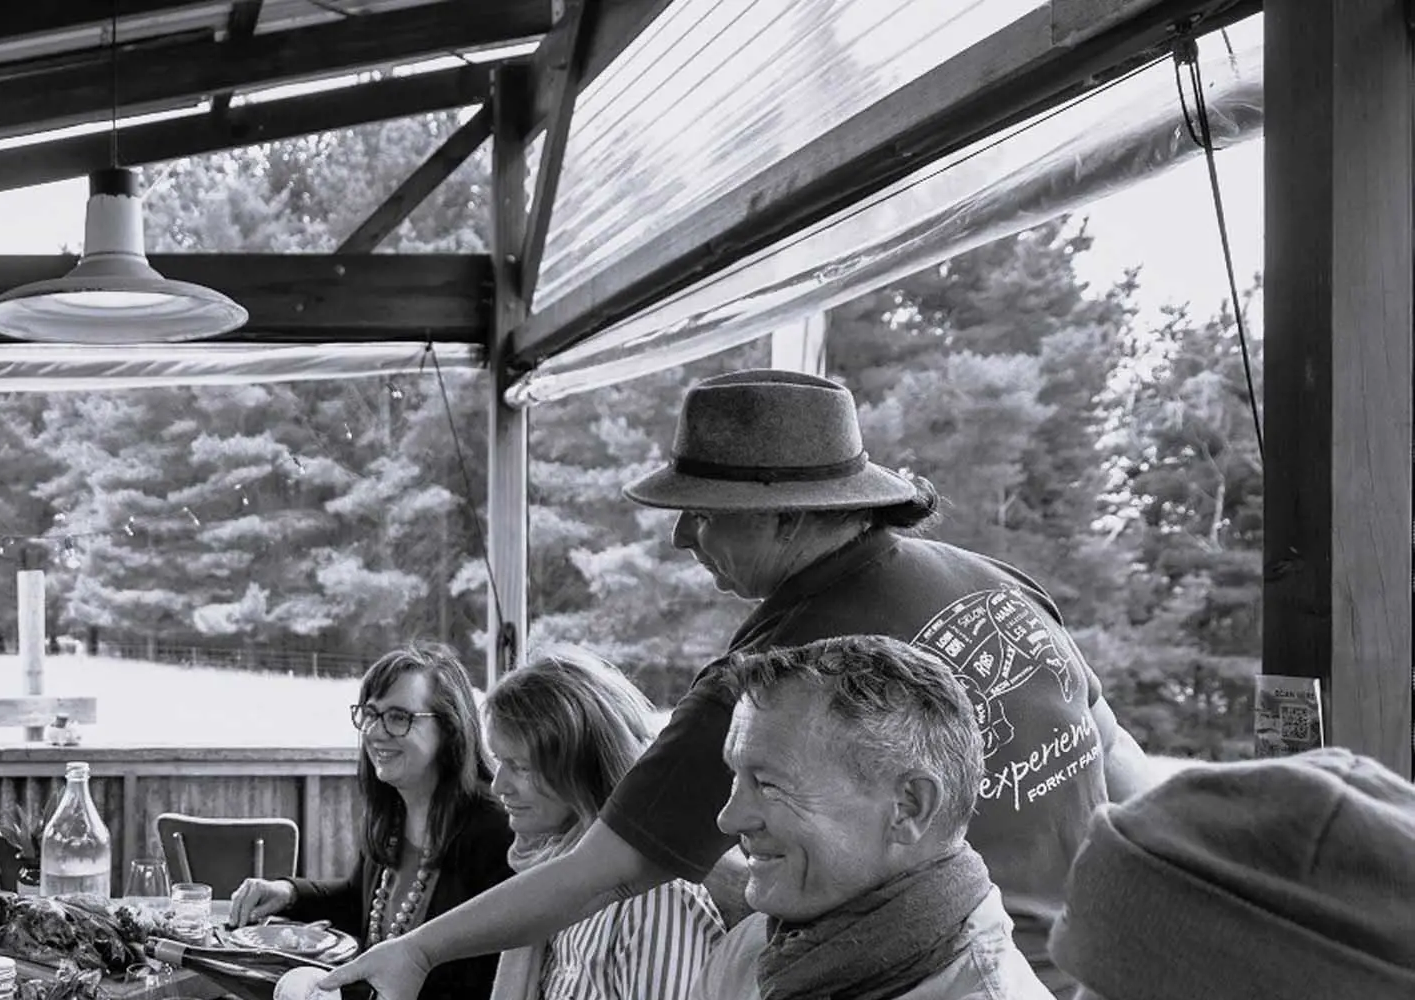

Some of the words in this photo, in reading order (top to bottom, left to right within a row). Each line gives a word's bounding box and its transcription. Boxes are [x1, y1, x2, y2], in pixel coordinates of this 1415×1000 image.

[1027, 769, 1067, 802] FORK
[1066, 760, 1079, 778] IT
[1078, 746, 1100, 769] FAR
